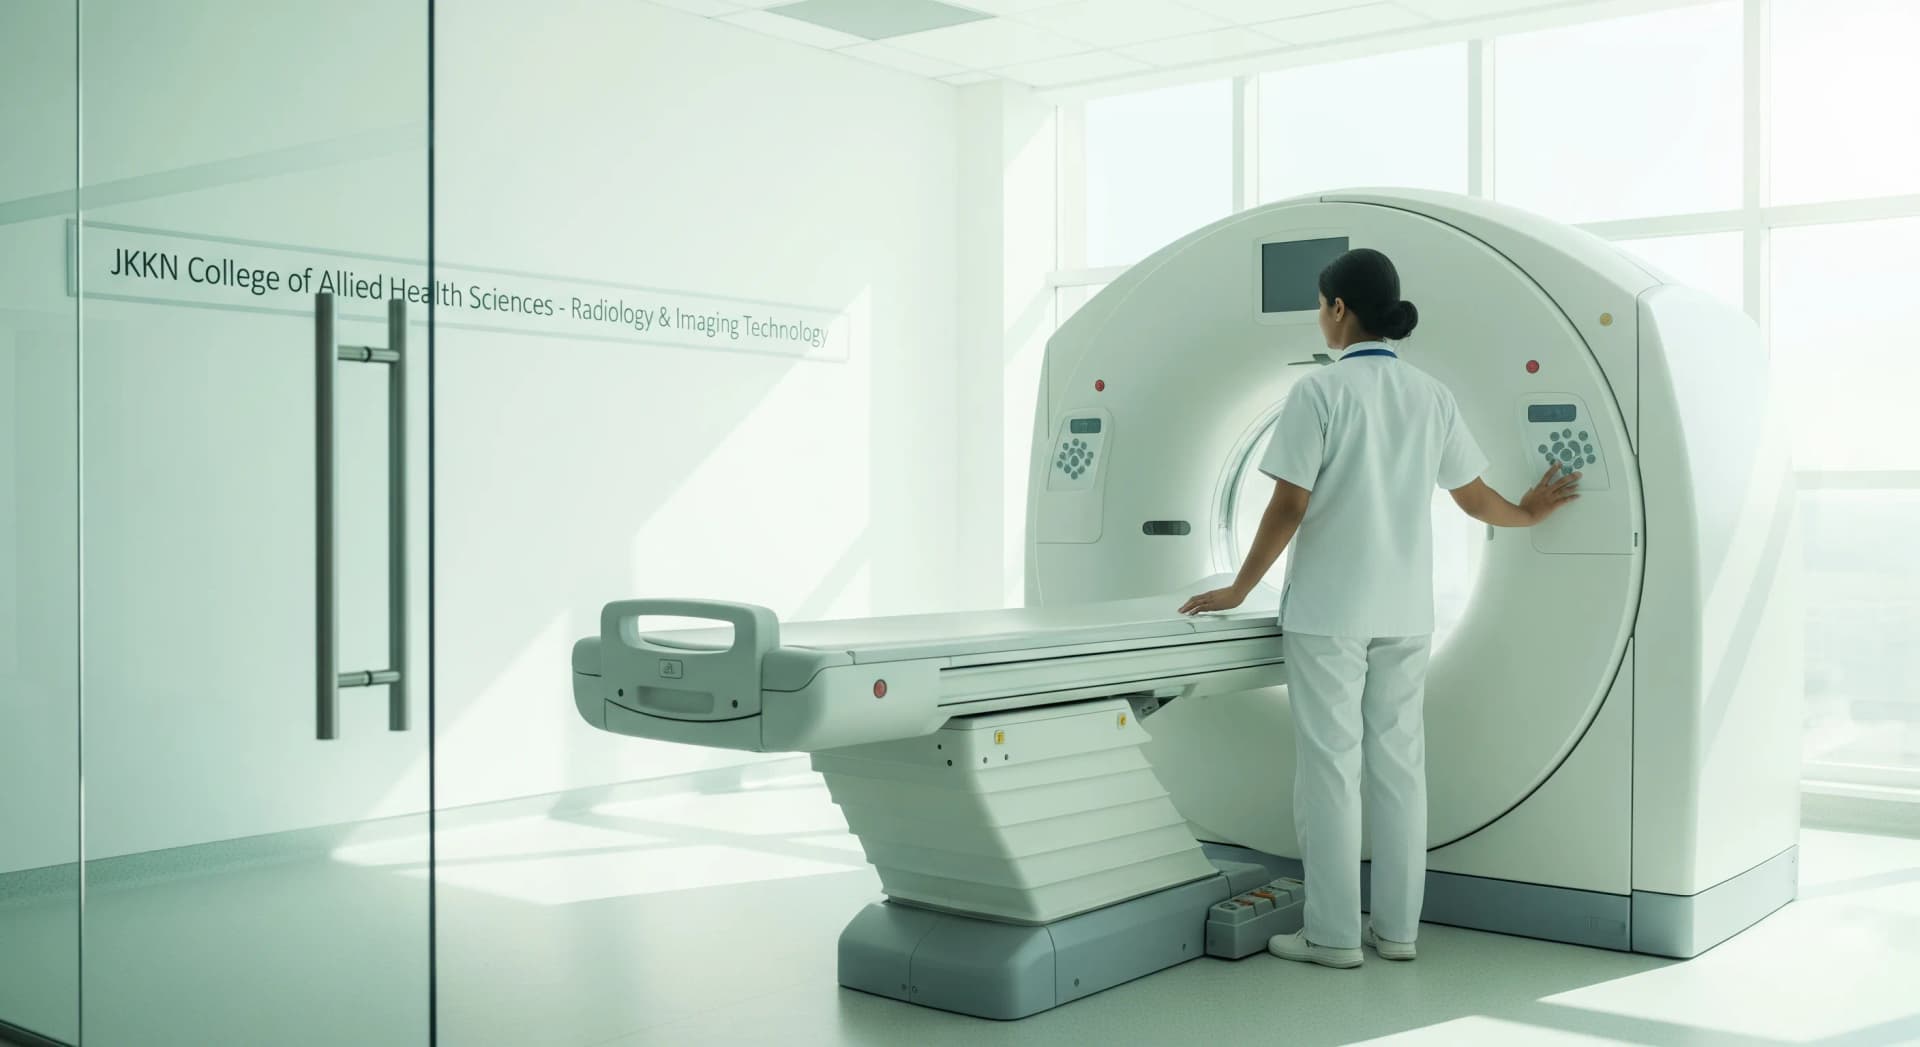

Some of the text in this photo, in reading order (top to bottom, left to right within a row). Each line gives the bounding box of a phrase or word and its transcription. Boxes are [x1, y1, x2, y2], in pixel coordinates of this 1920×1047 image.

[110, 248, 178, 281] JKKN
[188, 256, 280, 296] College
[288, 267, 313, 294] of
[319, 270, 382, 300] Allied
[469, 285, 554, 316] Sciences
[571, 297, 655, 332] Radiology
[658, 306, 671, 328] &
[676, 307, 740, 340] Imaging
[743, 315, 829, 348] Technology
